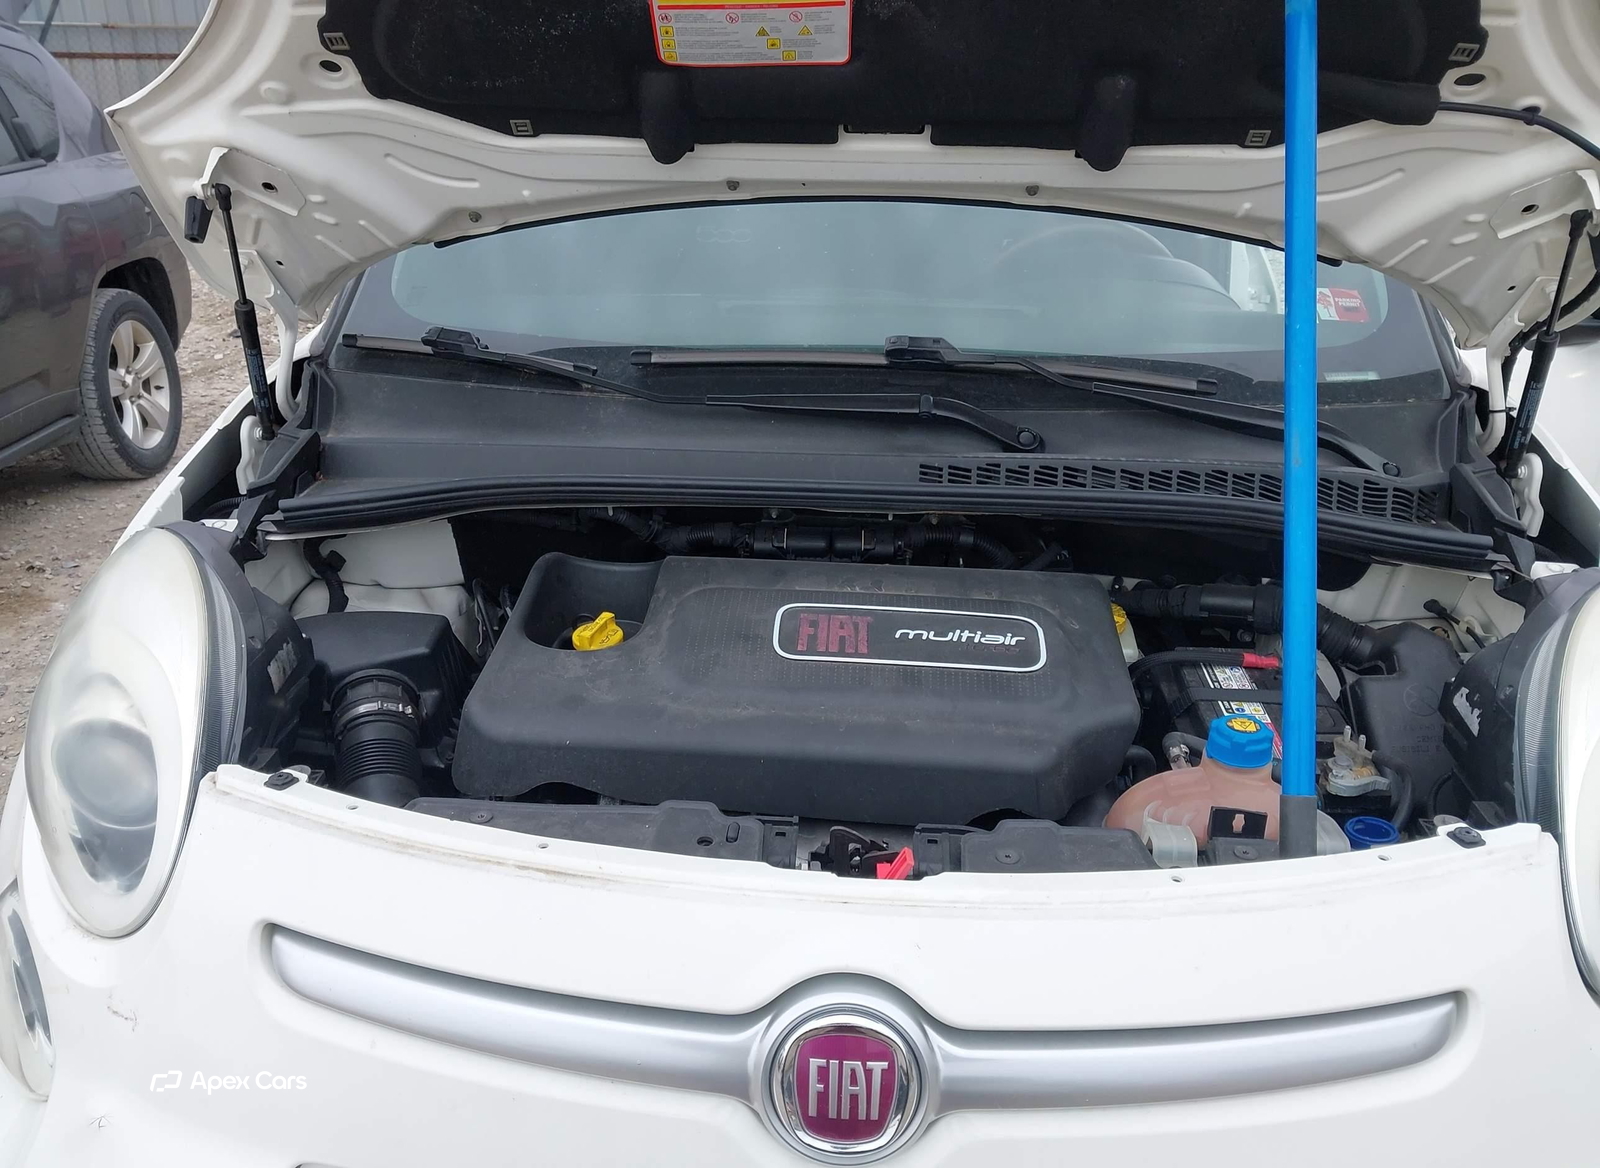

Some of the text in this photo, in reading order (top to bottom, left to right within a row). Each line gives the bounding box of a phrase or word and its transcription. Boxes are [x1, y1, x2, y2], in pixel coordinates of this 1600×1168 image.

[797, 613, 1026, 654] FIAT multiair
[808, 1057, 889, 1121] FIAT
